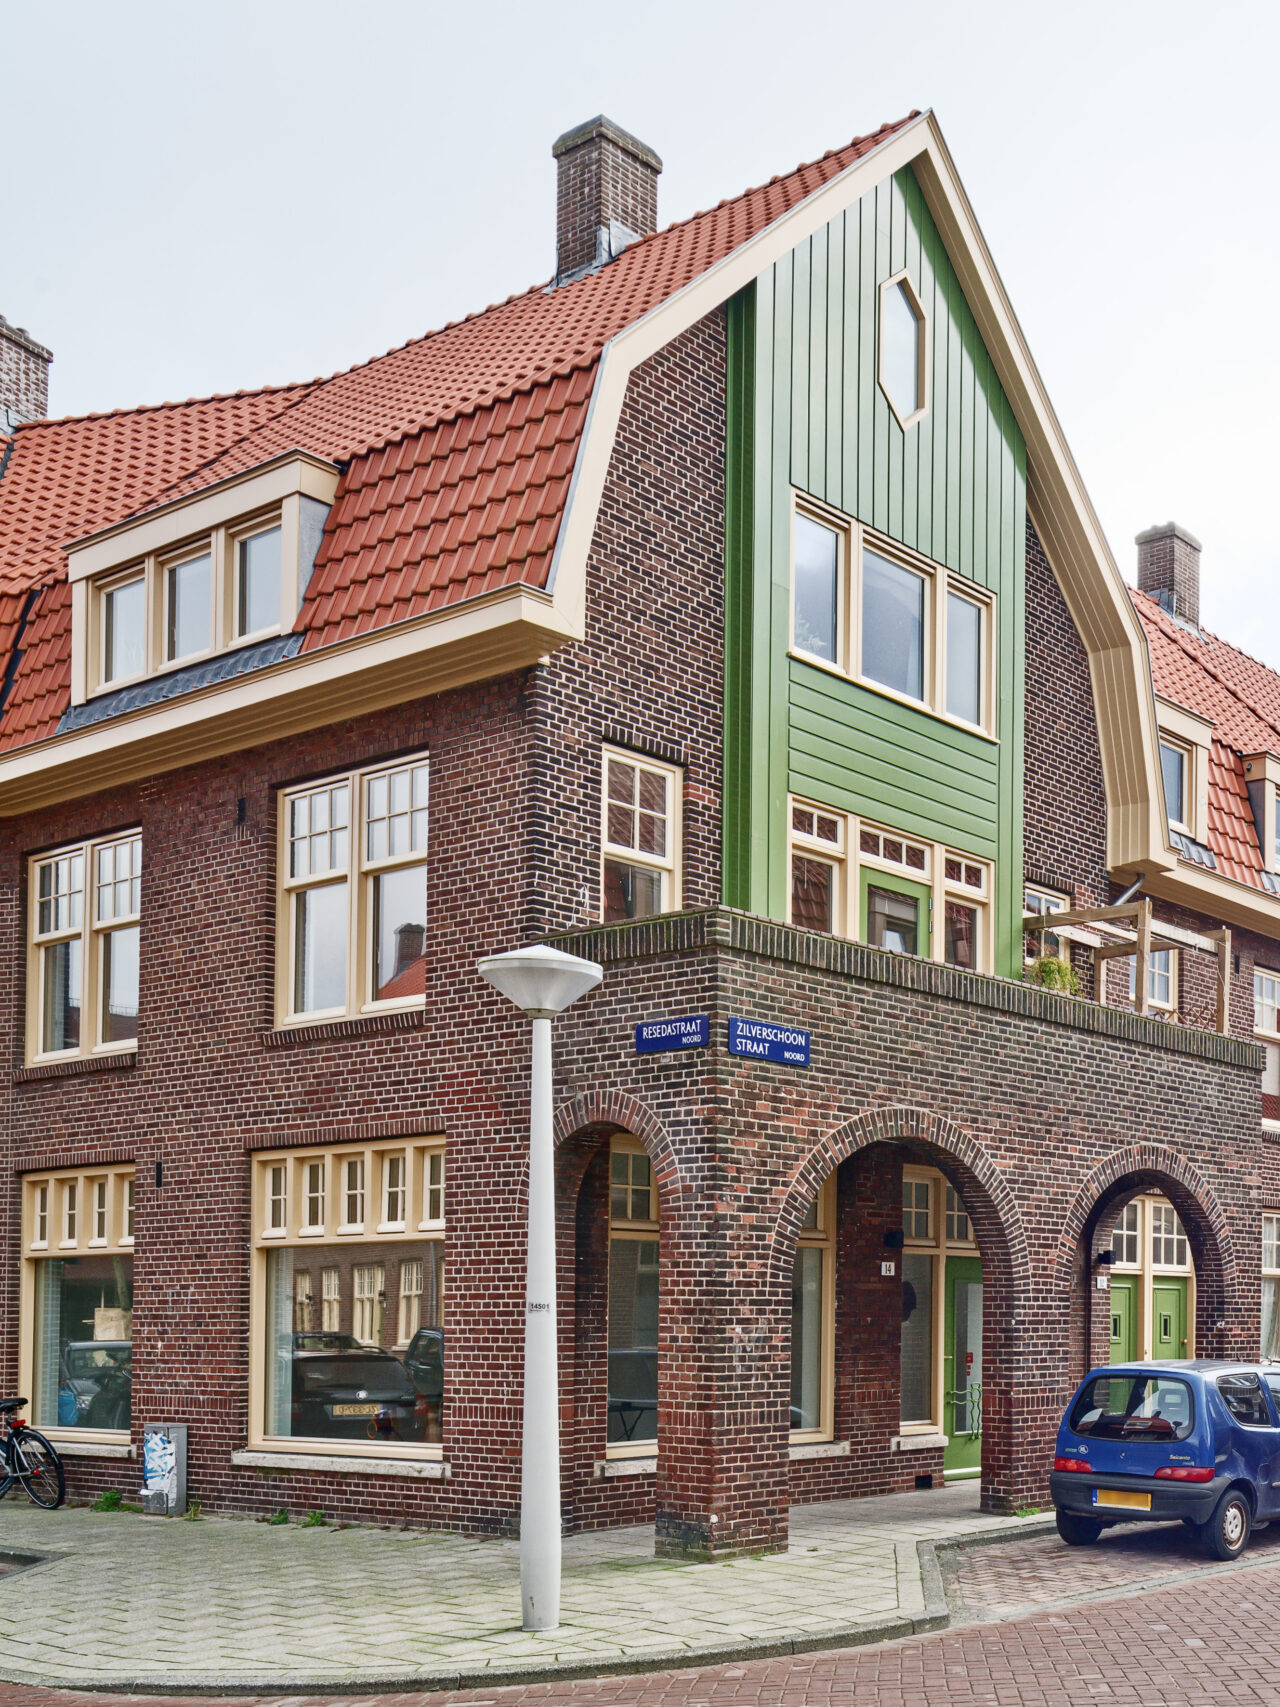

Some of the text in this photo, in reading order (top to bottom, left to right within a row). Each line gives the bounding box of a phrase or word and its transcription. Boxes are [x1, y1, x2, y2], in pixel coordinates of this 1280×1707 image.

[642, 1019, 701, 1039] RESEDASTRAAT
[736, 1022, 806, 1046] ZILVERSCHOON
[682, 1034, 701, 1044] NOORD
[736, 1038, 770, 1055] STRAAT
[784, 1051, 805, 1062] NOORD
[885, 1263, 892, 1275] 14
